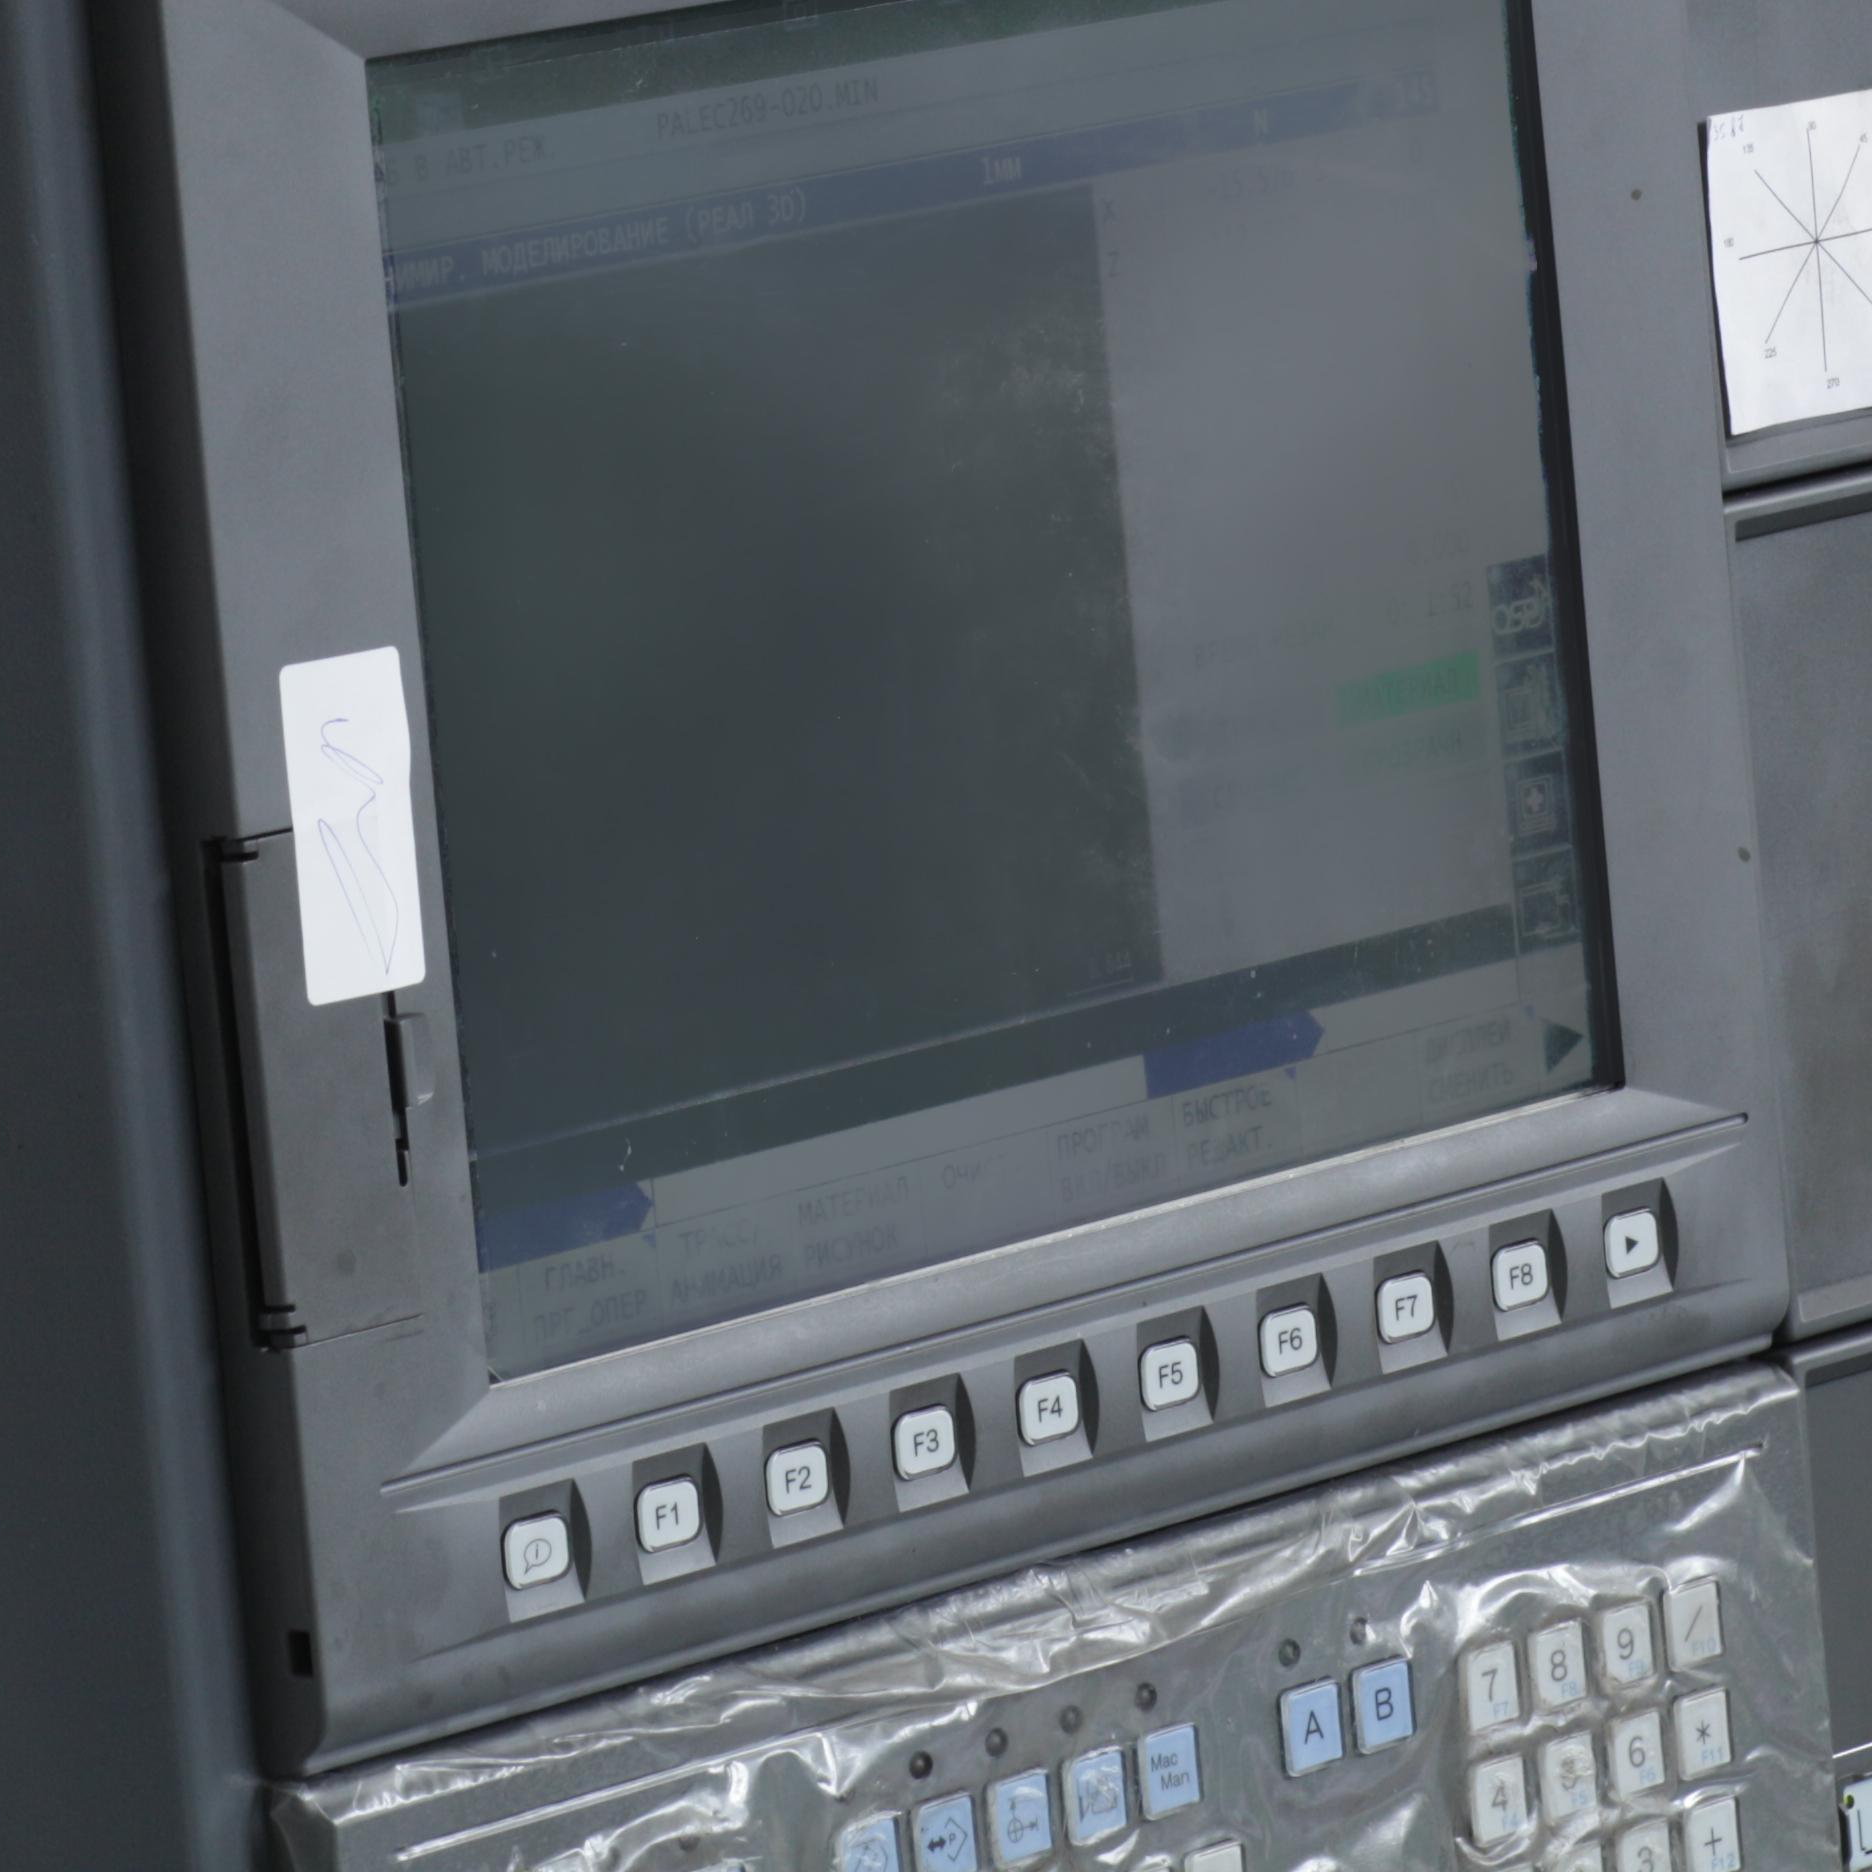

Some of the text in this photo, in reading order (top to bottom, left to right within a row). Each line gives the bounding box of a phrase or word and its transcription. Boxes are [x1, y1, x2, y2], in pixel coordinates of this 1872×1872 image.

[445, 134, 557, 178] АВТ.РЕЖ.
[482, 215, 670, 276] МОДЕЛИРОВАНИЕ
[1181, 1082, 1274, 1129] БЫСТРОЕ
[797, 1175, 911, 1230] МАТЕРИАЛ
[803, 1223, 900, 1271] РИСУНОК
[542, 1254, 628, 1293] ГЛАВН.
[669, 1252, 784, 1309] АНИМАЦИЯ
[1509, 1264, 1534, 1290] F8
[1394, 1296, 1418, 1321] F7
[1278, 1328, 1303, 1355] F6
[1158, 1361, 1185, 1389] F5
[1037, 1394, 1064, 1422] F4
[913, 1428, 940, 1458] F3
[784, 1466, 812, 1495] F2
[655, 1503, 681, 1532] F1
[1617, 1627, 1635, 1660] 9
[1550, 1649, 1568, 1682] 8
[1628, 1658, 1646, 1675] F9
[1481, 1668, 1499, 1703] 7
[1561, 1681, 1578, 1698] F8
[1374, 1688, 1394, 1722] B
[1492, 1701, 1510, 1719] F7
[1304, 1710, 1324, 1745] A
[1150, 1751, 1179, 1772] Mac
[1628, 1735, 1646, 1769] 6
[1160, 1769, 1190, 1792] Man
[1490, 1784, 1509, 1812] 4
